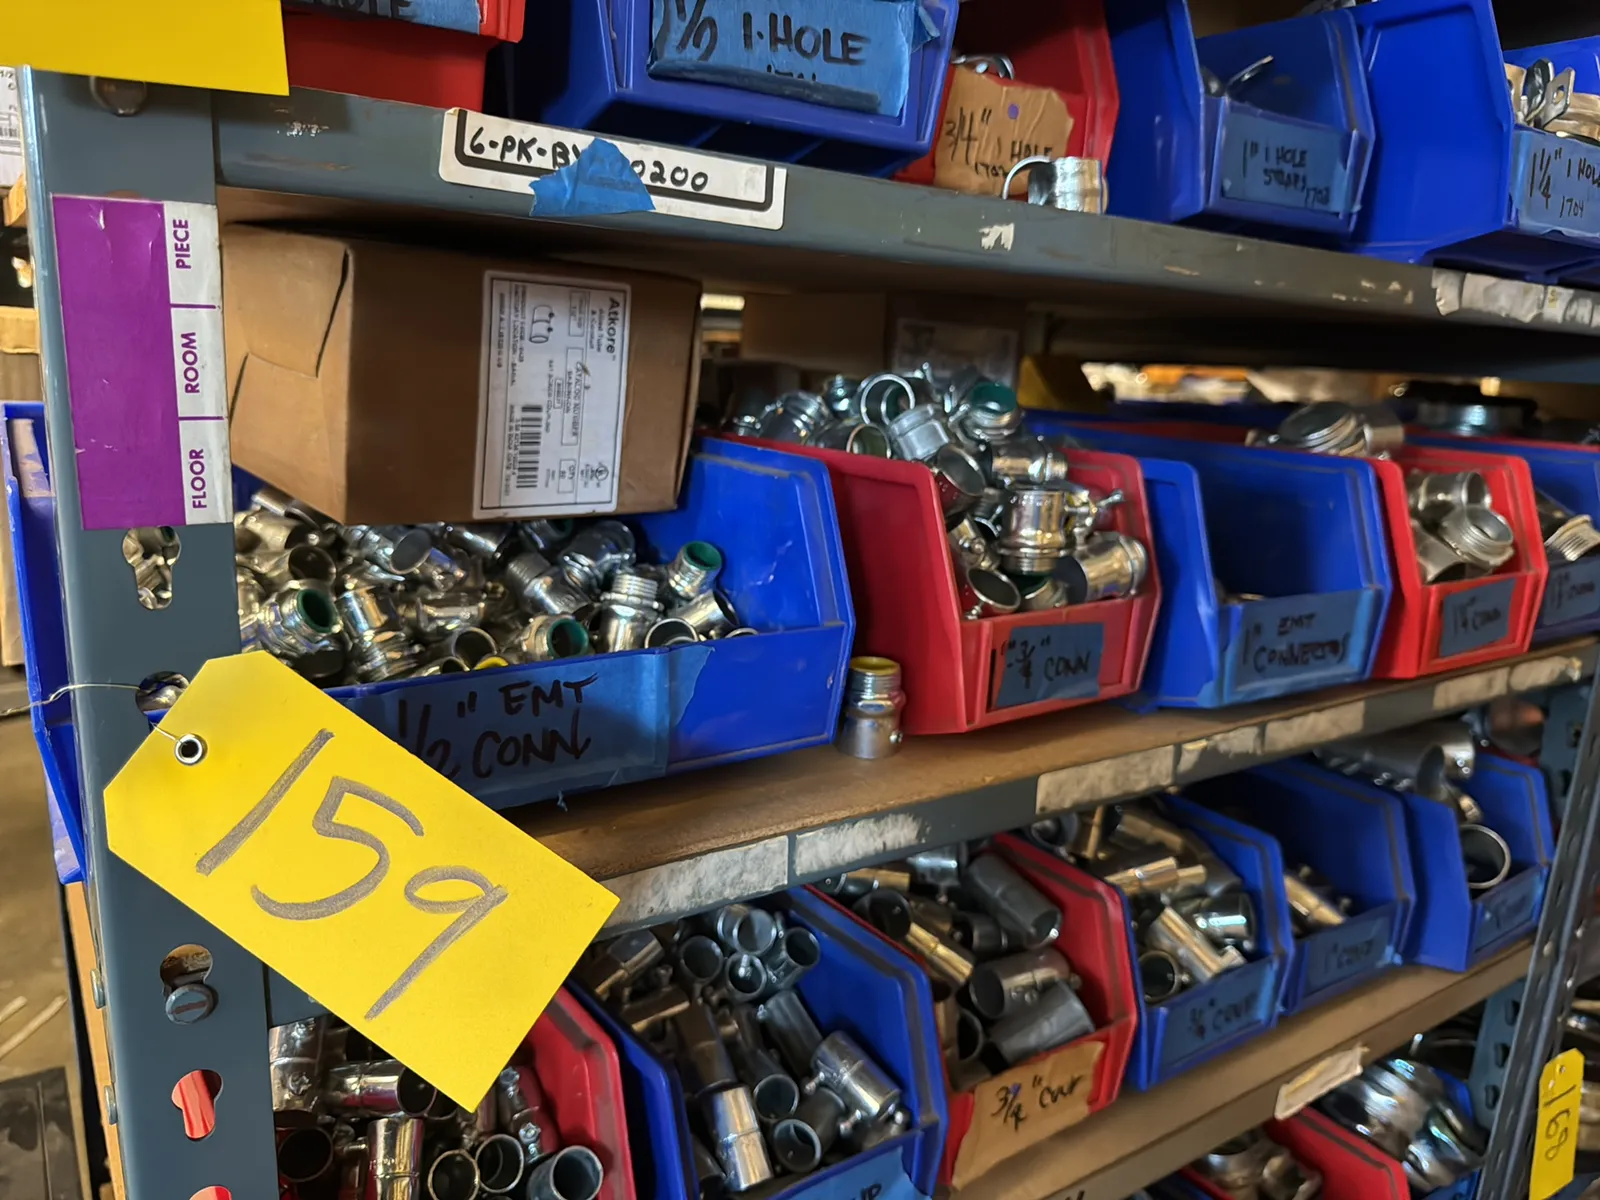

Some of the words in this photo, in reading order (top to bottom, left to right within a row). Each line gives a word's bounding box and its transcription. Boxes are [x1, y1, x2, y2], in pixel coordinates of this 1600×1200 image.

[1276, 146, 1307, 168] HOLE
[173, 218, 191, 269] PIECE
[181, 331, 200, 394] ROOM
[189, 448, 207, 508] FLOOR
[498, 672, 599, 716] EMT
[472, 708, 592, 779] CONN
[196, 728, 510, 1021] 159
[1542, 1083, 1577, 1161] 168
